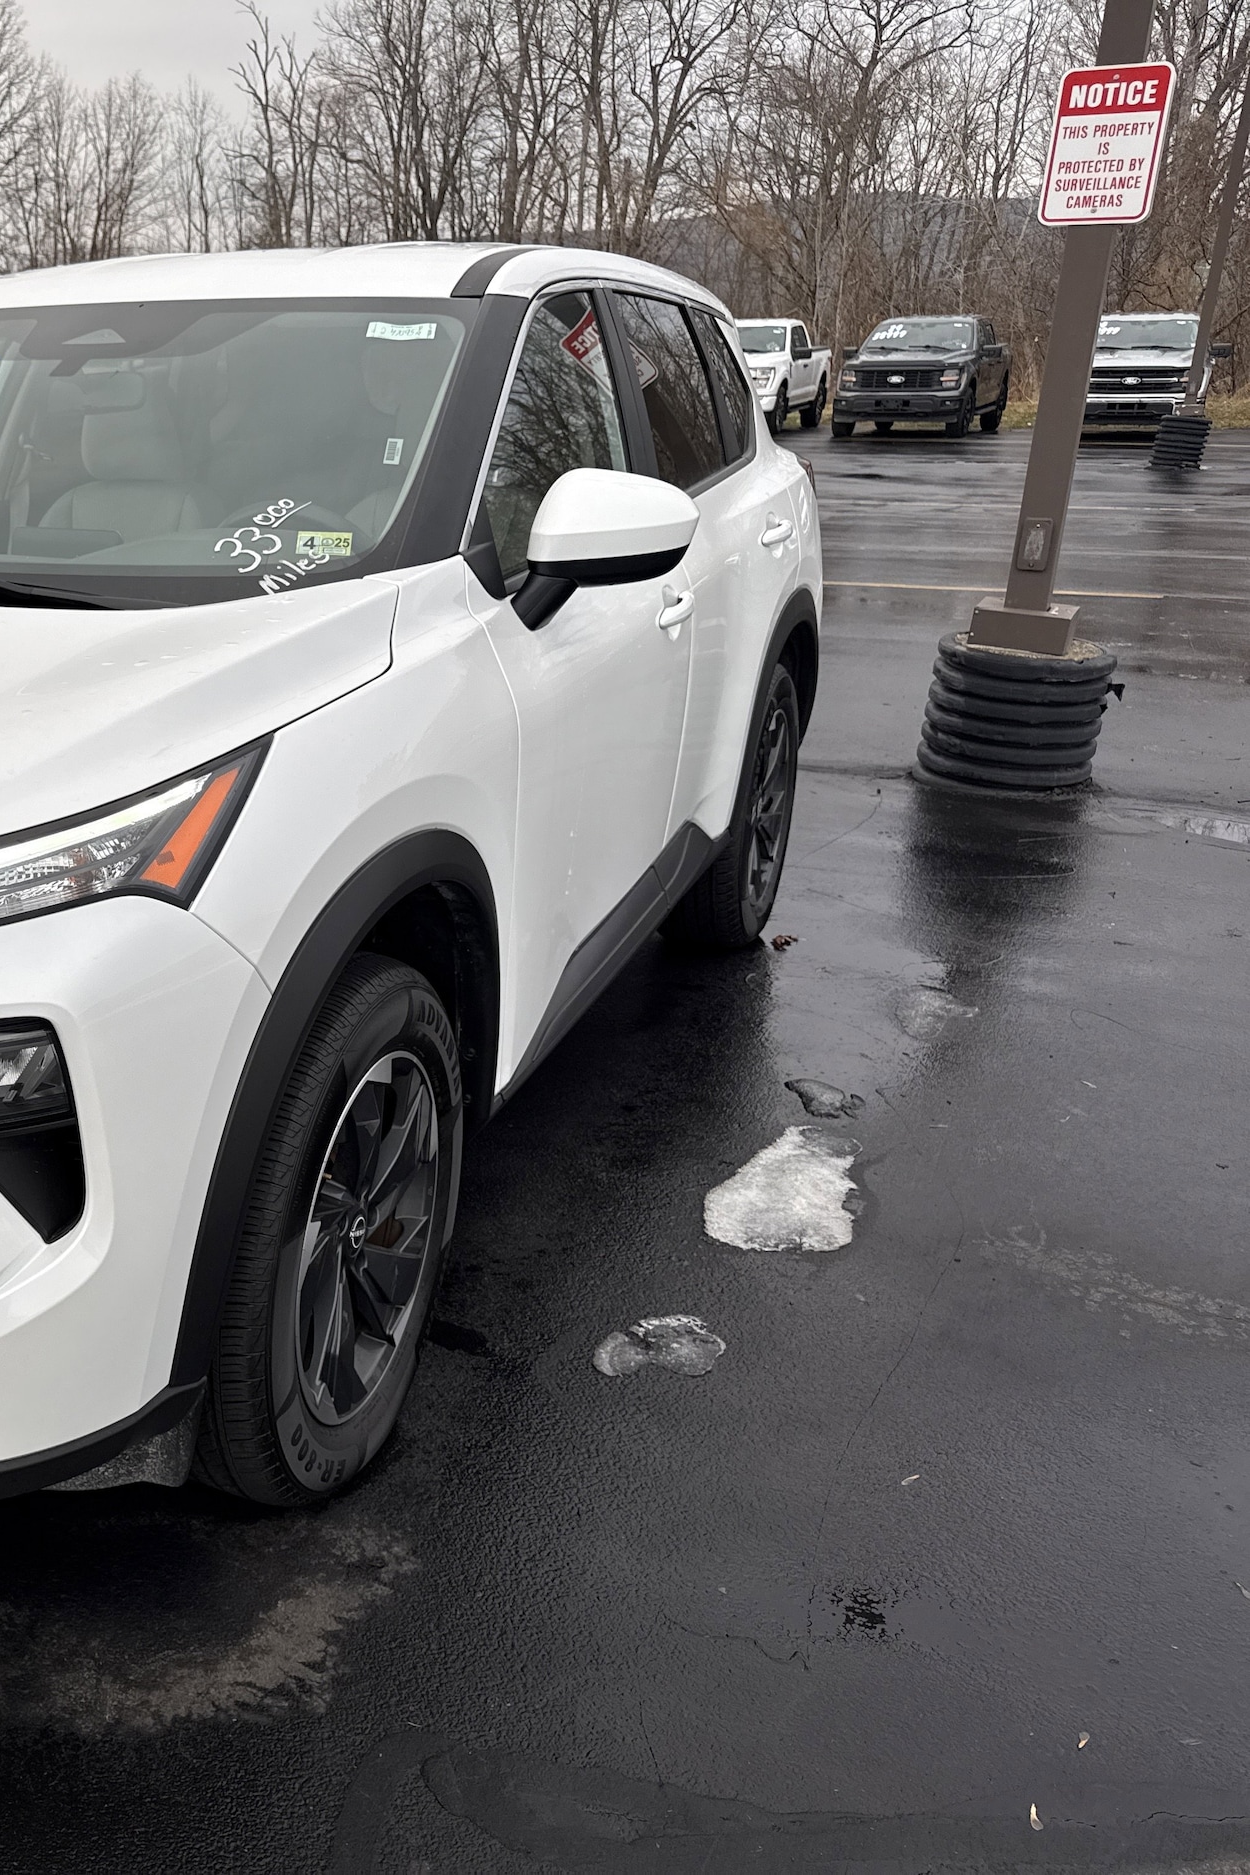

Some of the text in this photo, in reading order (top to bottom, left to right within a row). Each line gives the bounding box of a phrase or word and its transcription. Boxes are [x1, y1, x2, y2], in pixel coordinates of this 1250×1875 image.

[1069, 80, 1159, 109] NOTICE
[1062, 122, 1156, 139] THIS PROPERTY
[1097, 142, 1110, 155] IS
[1057, 158, 1145, 174] PROTECTED BY
[1054, 176, 1141, 192] SURVEILLANCE
[1066, 194, 1123, 209] CAMERAS
[302, 536, 350, 550] 4 25
[258, 549, 330, 595] Miles
[291, 1423, 346, 1482] ER-800
